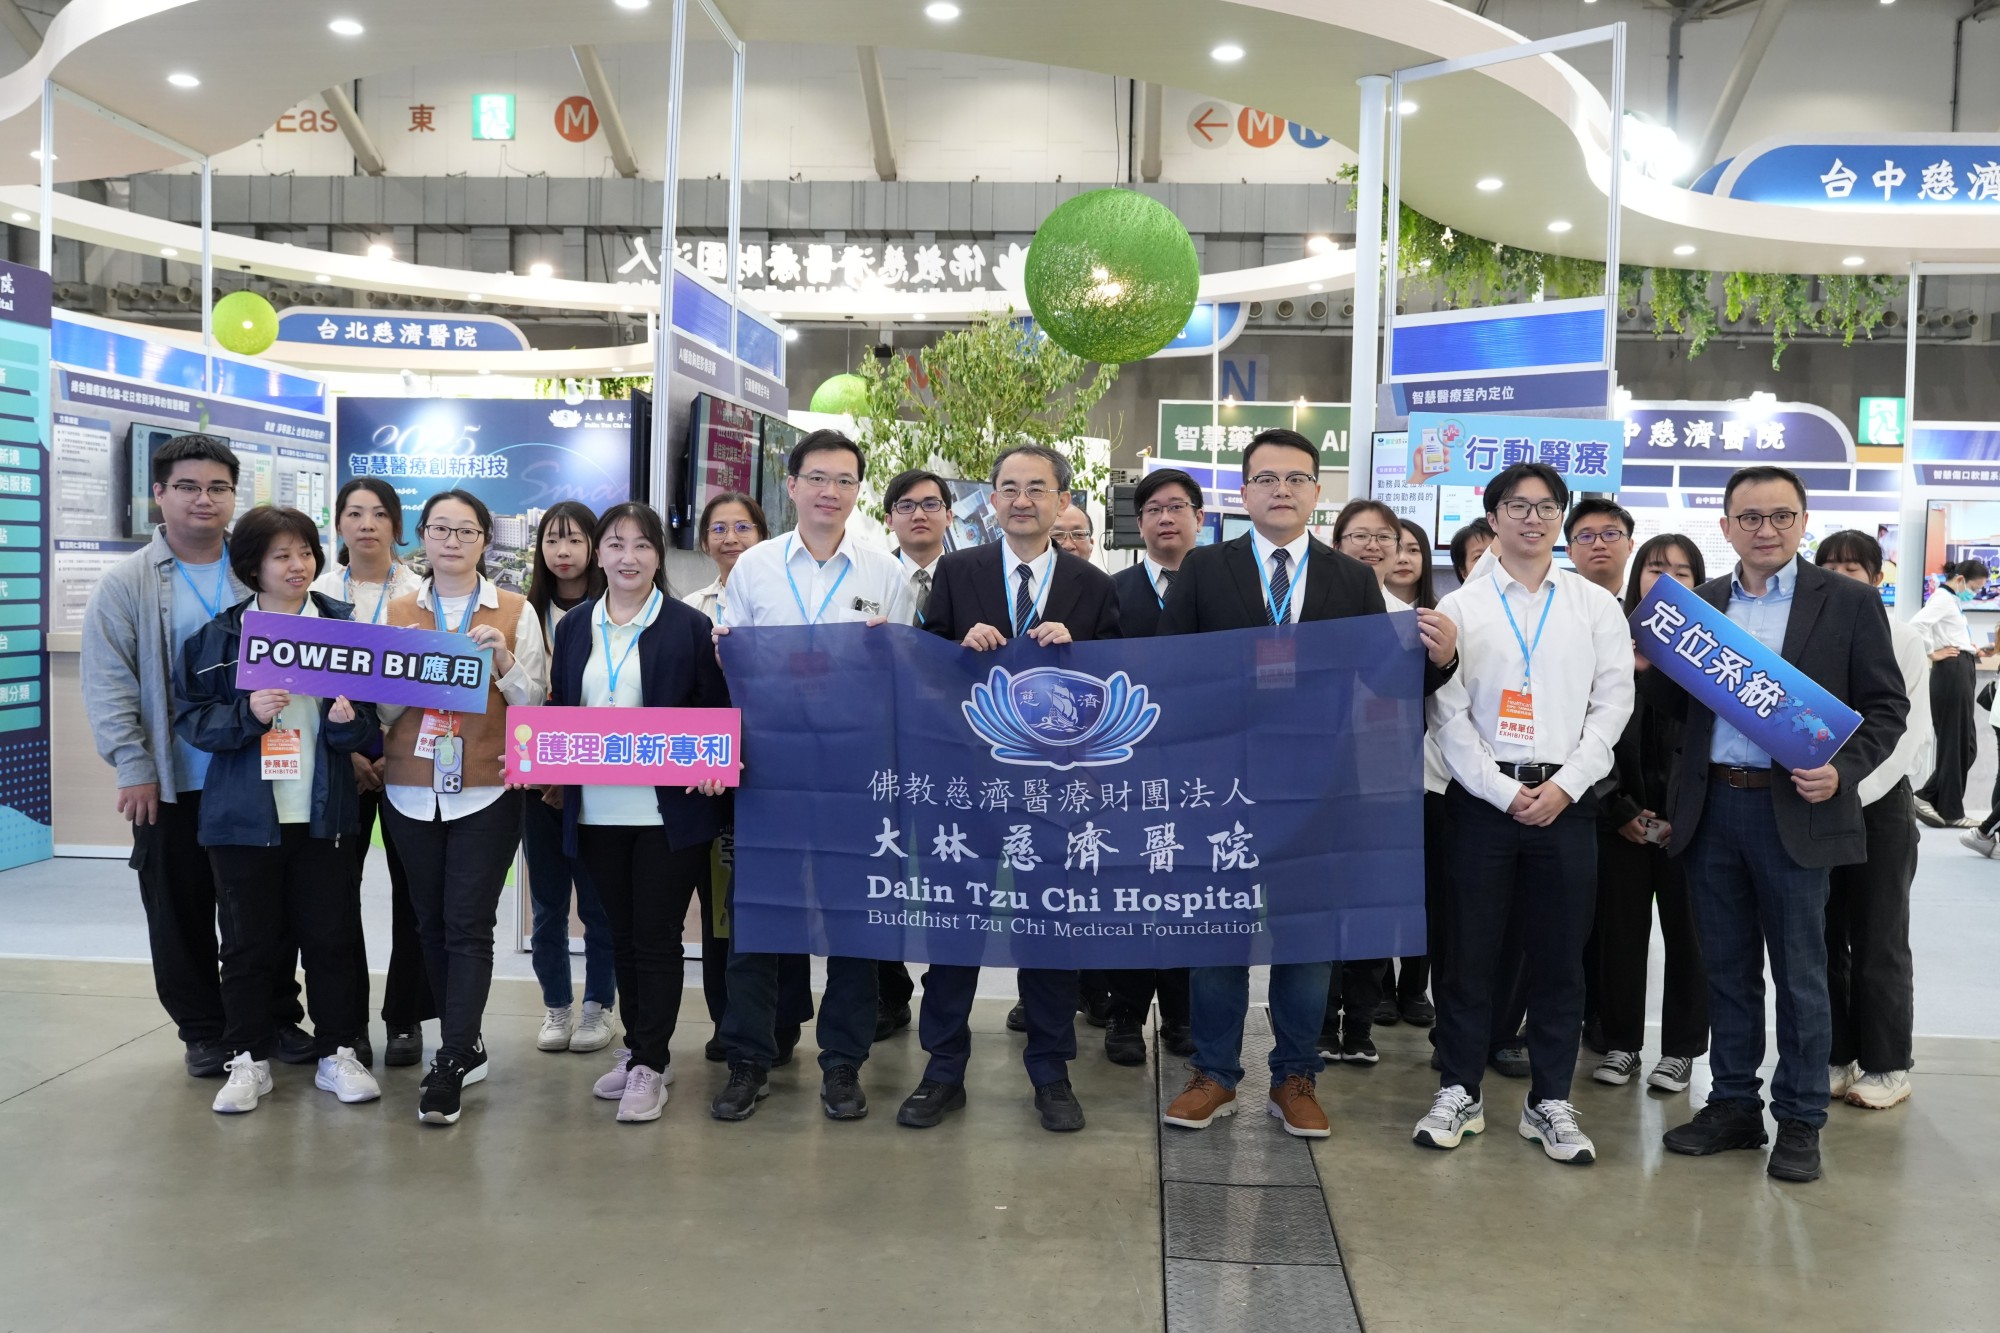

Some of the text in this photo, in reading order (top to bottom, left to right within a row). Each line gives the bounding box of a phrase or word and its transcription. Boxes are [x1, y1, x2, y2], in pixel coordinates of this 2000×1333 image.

[275, 110, 338, 133] Eas
[408, 104, 436, 132] 東
[563, 105, 589, 135] M
[1247, 109, 1275, 140] M
[1820, 158, 2000, 201] 台中慈濟
[317, 317, 478, 348] 台北慈濟醫院
[1222, 360, 1256, 401] N
[1412, 386, 1515, 405] 智慧醫療室內定位
[584, 411, 631, 422] 大林慈濟
[350, 454, 508, 477] 智慧醫療創新科技
[1465, 436, 1610, 475] 行動醫療
[1933, 470, 2000, 480] 智慧傷口軟體系
[249, 639, 480, 686] POWER BI應用
[1641, 600, 1786, 719] 定位系統
[1020, 690, 1101, 708] 慈 濟
[1499, 730, 1534, 740] EXHIBITOR
[1500, 721, 1534, 735] 參展單位
[264, 760, 298, 768] 參展單位
[538, 732, 732, 766] 護理創新專利
[867, 768, 1256, 814] 佛教慈濟醫療財團法人
[869, 817, 1260, 876] 大林慈濟醫院
[867, 875, 1263, 917] Dalin Tzu Chi Hospital
[867, 910, 1263, 938] Buddhist Tzu Chi Medical Foundation
